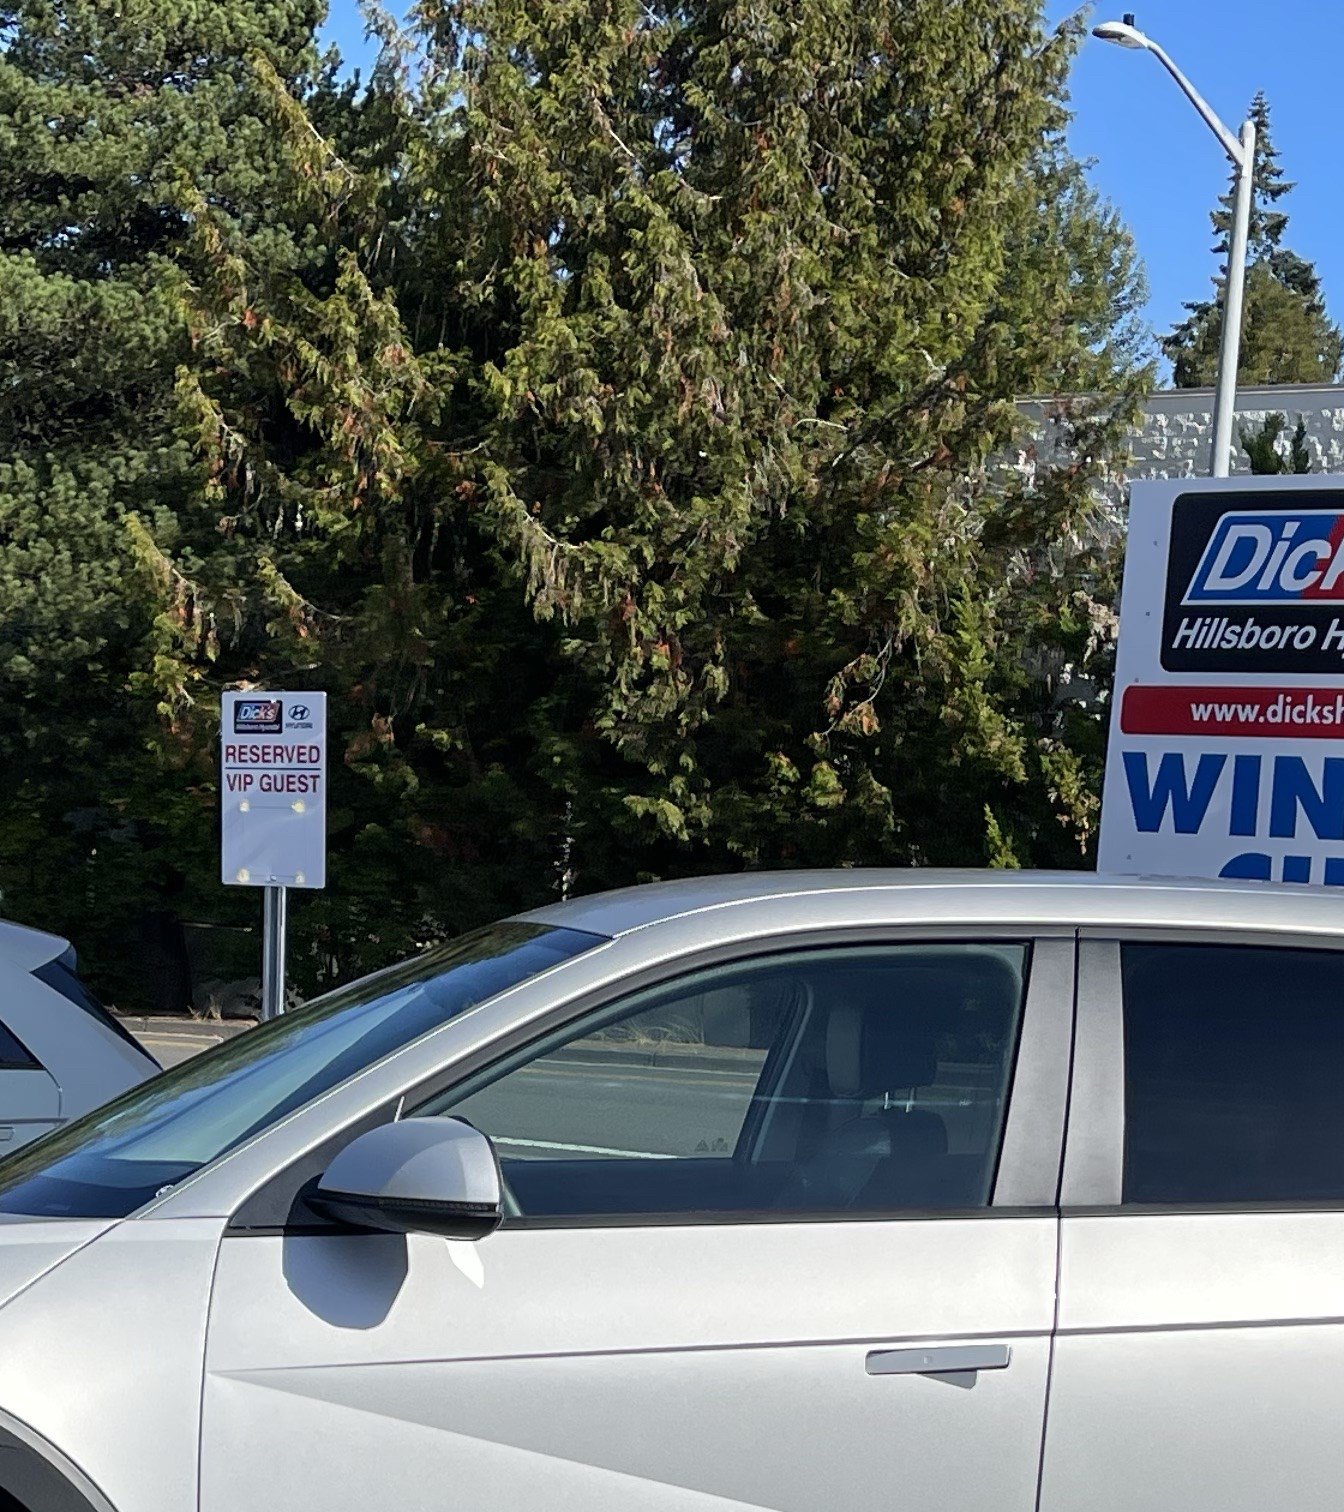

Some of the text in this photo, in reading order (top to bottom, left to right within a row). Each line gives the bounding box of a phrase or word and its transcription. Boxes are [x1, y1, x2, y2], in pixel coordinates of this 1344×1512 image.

[1172, 617, 1317, 651] Hillsboro
[225, 745, 321, 764] RESERVED
[226, 774, 320, 793] VIP GUEST
